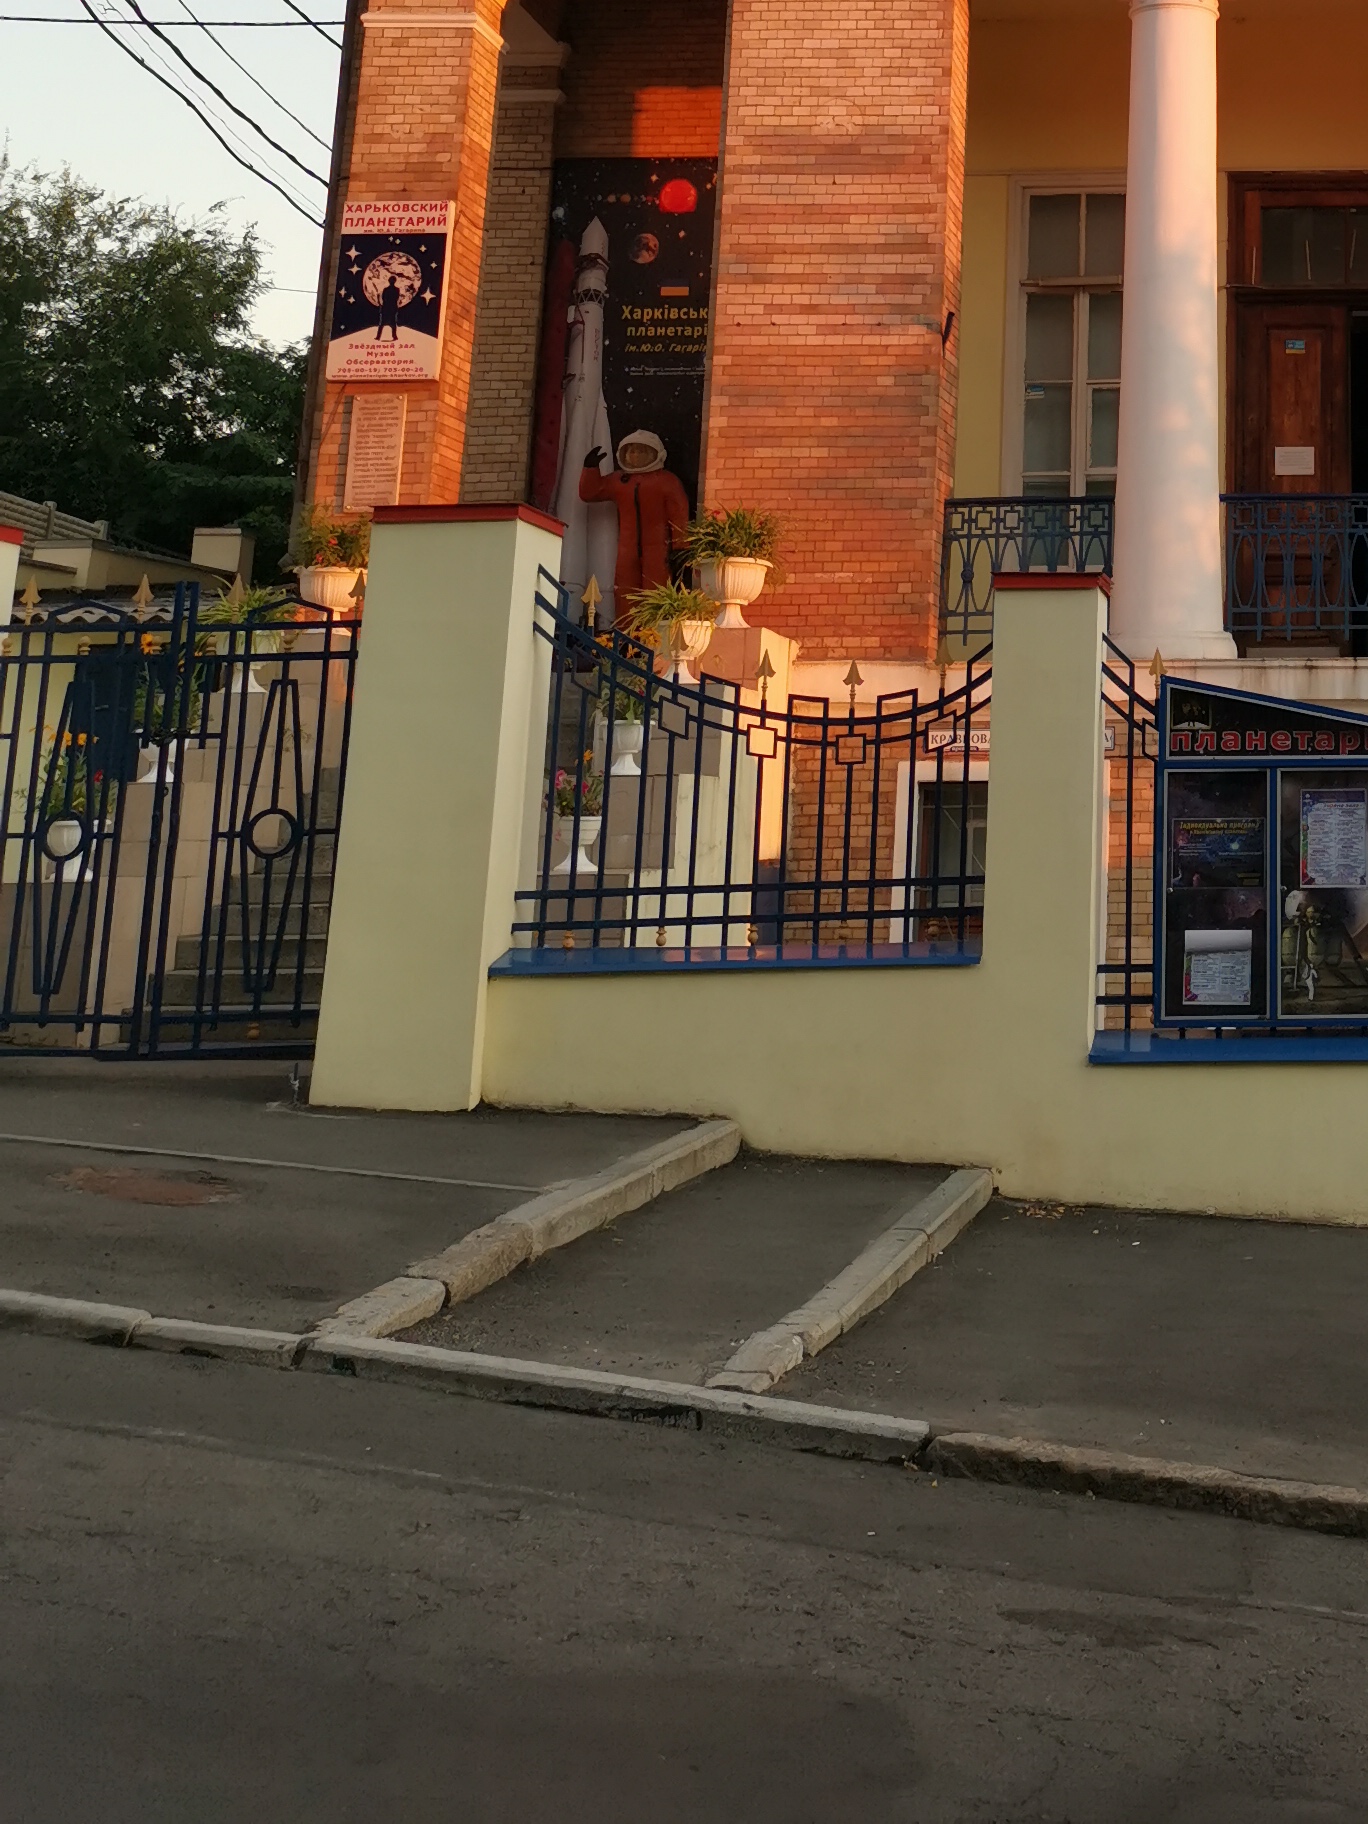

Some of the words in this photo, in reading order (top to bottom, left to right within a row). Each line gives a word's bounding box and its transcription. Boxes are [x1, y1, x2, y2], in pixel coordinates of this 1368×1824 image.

[345, 200, 449, 214] ХАРЬКОВСКИЙ
[344, 214, 447, 228] ПЛАНЕТАРИЙ
[366, 350, 396, 358] Музей
[346, 358, 415, 366] Обсерватория
